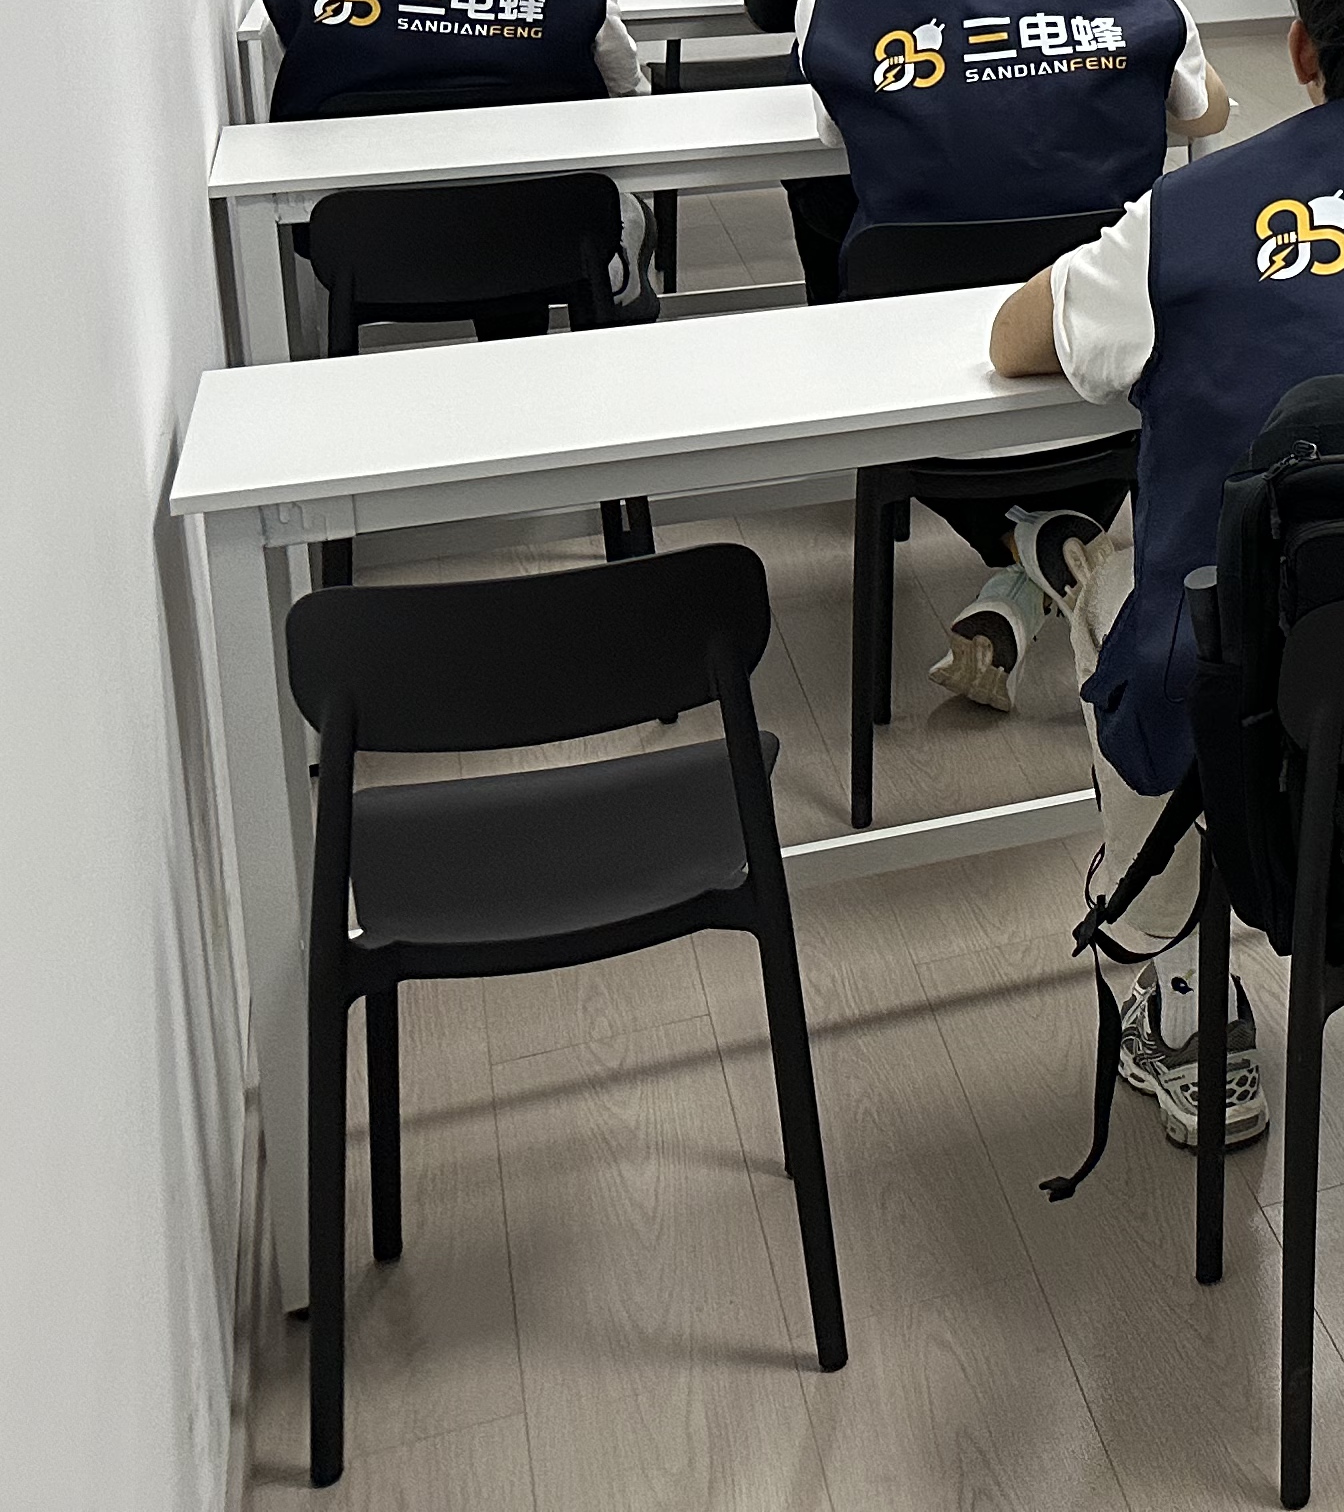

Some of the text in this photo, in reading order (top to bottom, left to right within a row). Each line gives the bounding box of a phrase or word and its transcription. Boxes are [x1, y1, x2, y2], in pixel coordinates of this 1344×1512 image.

[397, 18, 543, 38] SANDIANFENG
[963, 12, 1126, 63] 三电蜂
[965, 56, 1127, 83] SANDIANFENG
